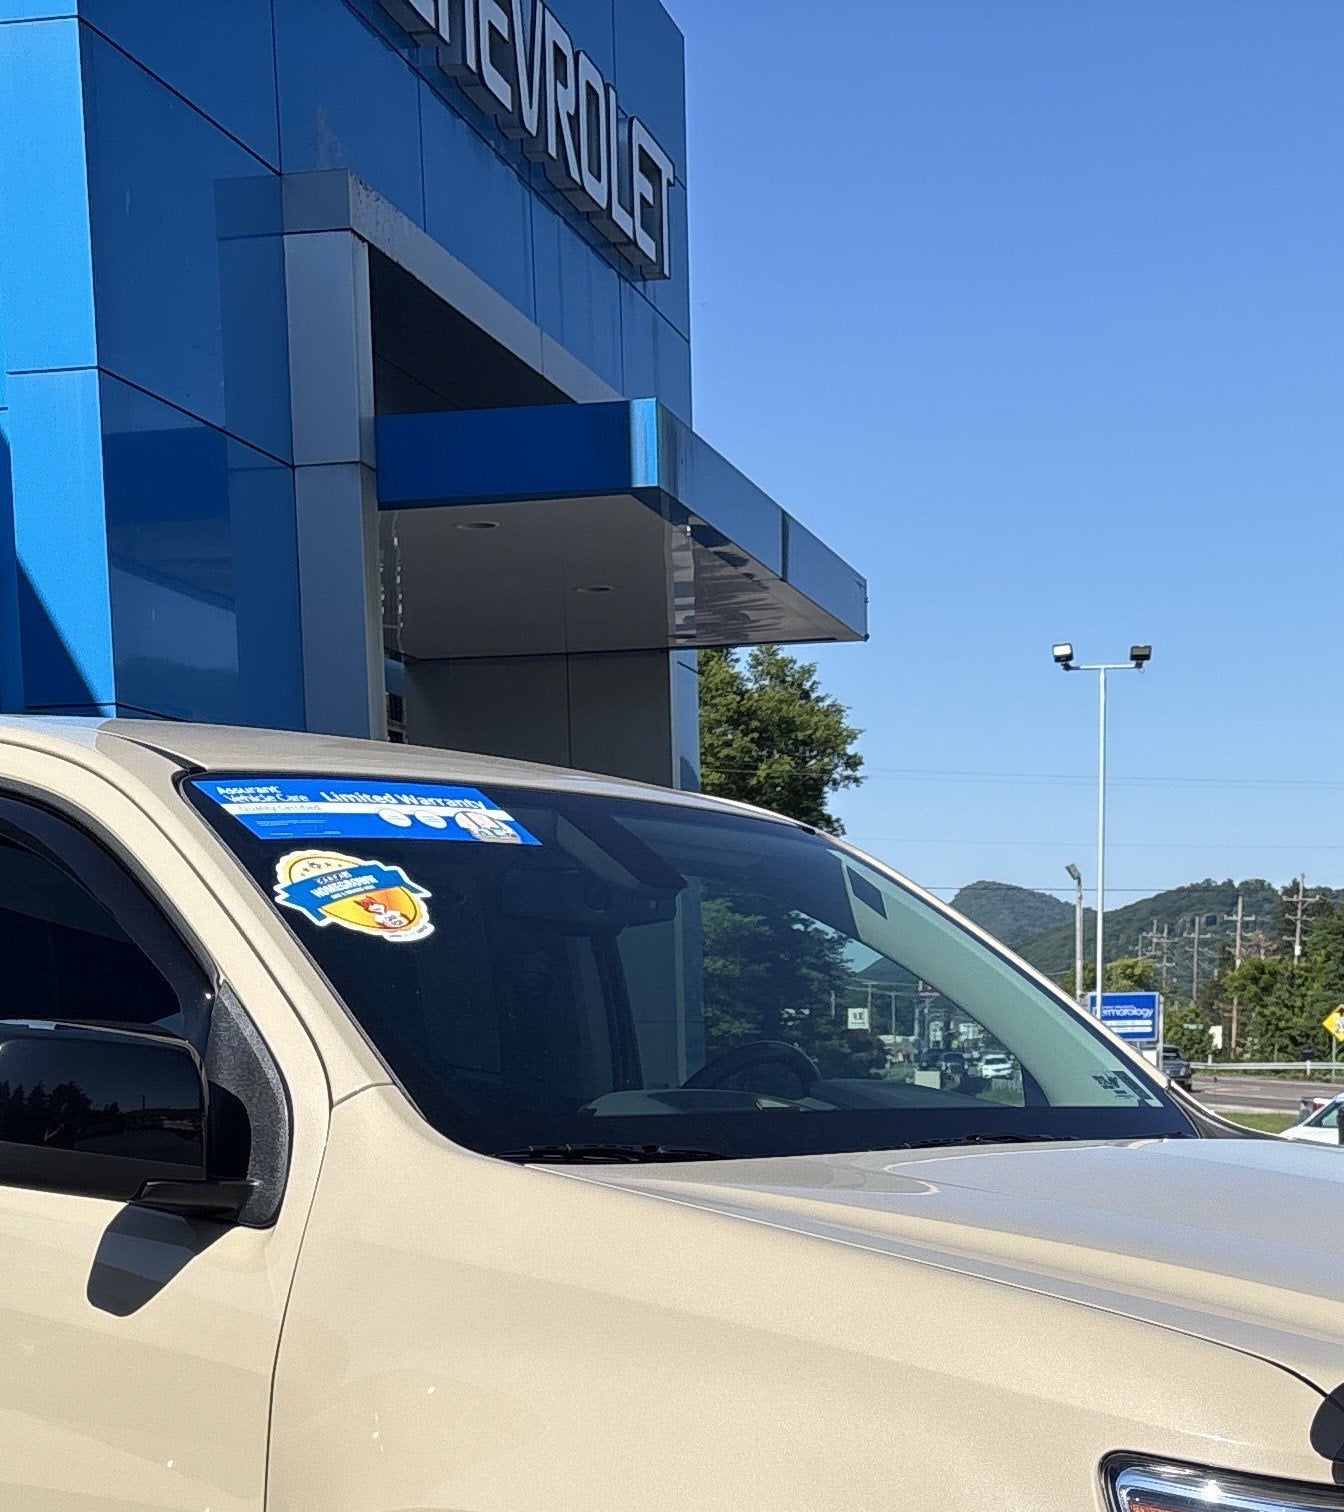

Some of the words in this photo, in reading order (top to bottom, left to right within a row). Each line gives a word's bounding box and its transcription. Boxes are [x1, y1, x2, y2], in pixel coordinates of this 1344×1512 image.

[408, 0, 674, 279] EVROLET
[276, 794, 310, 802] Care
[320, 791, 395, 805] Limited
[394, 793, 486, 810] Warranty
